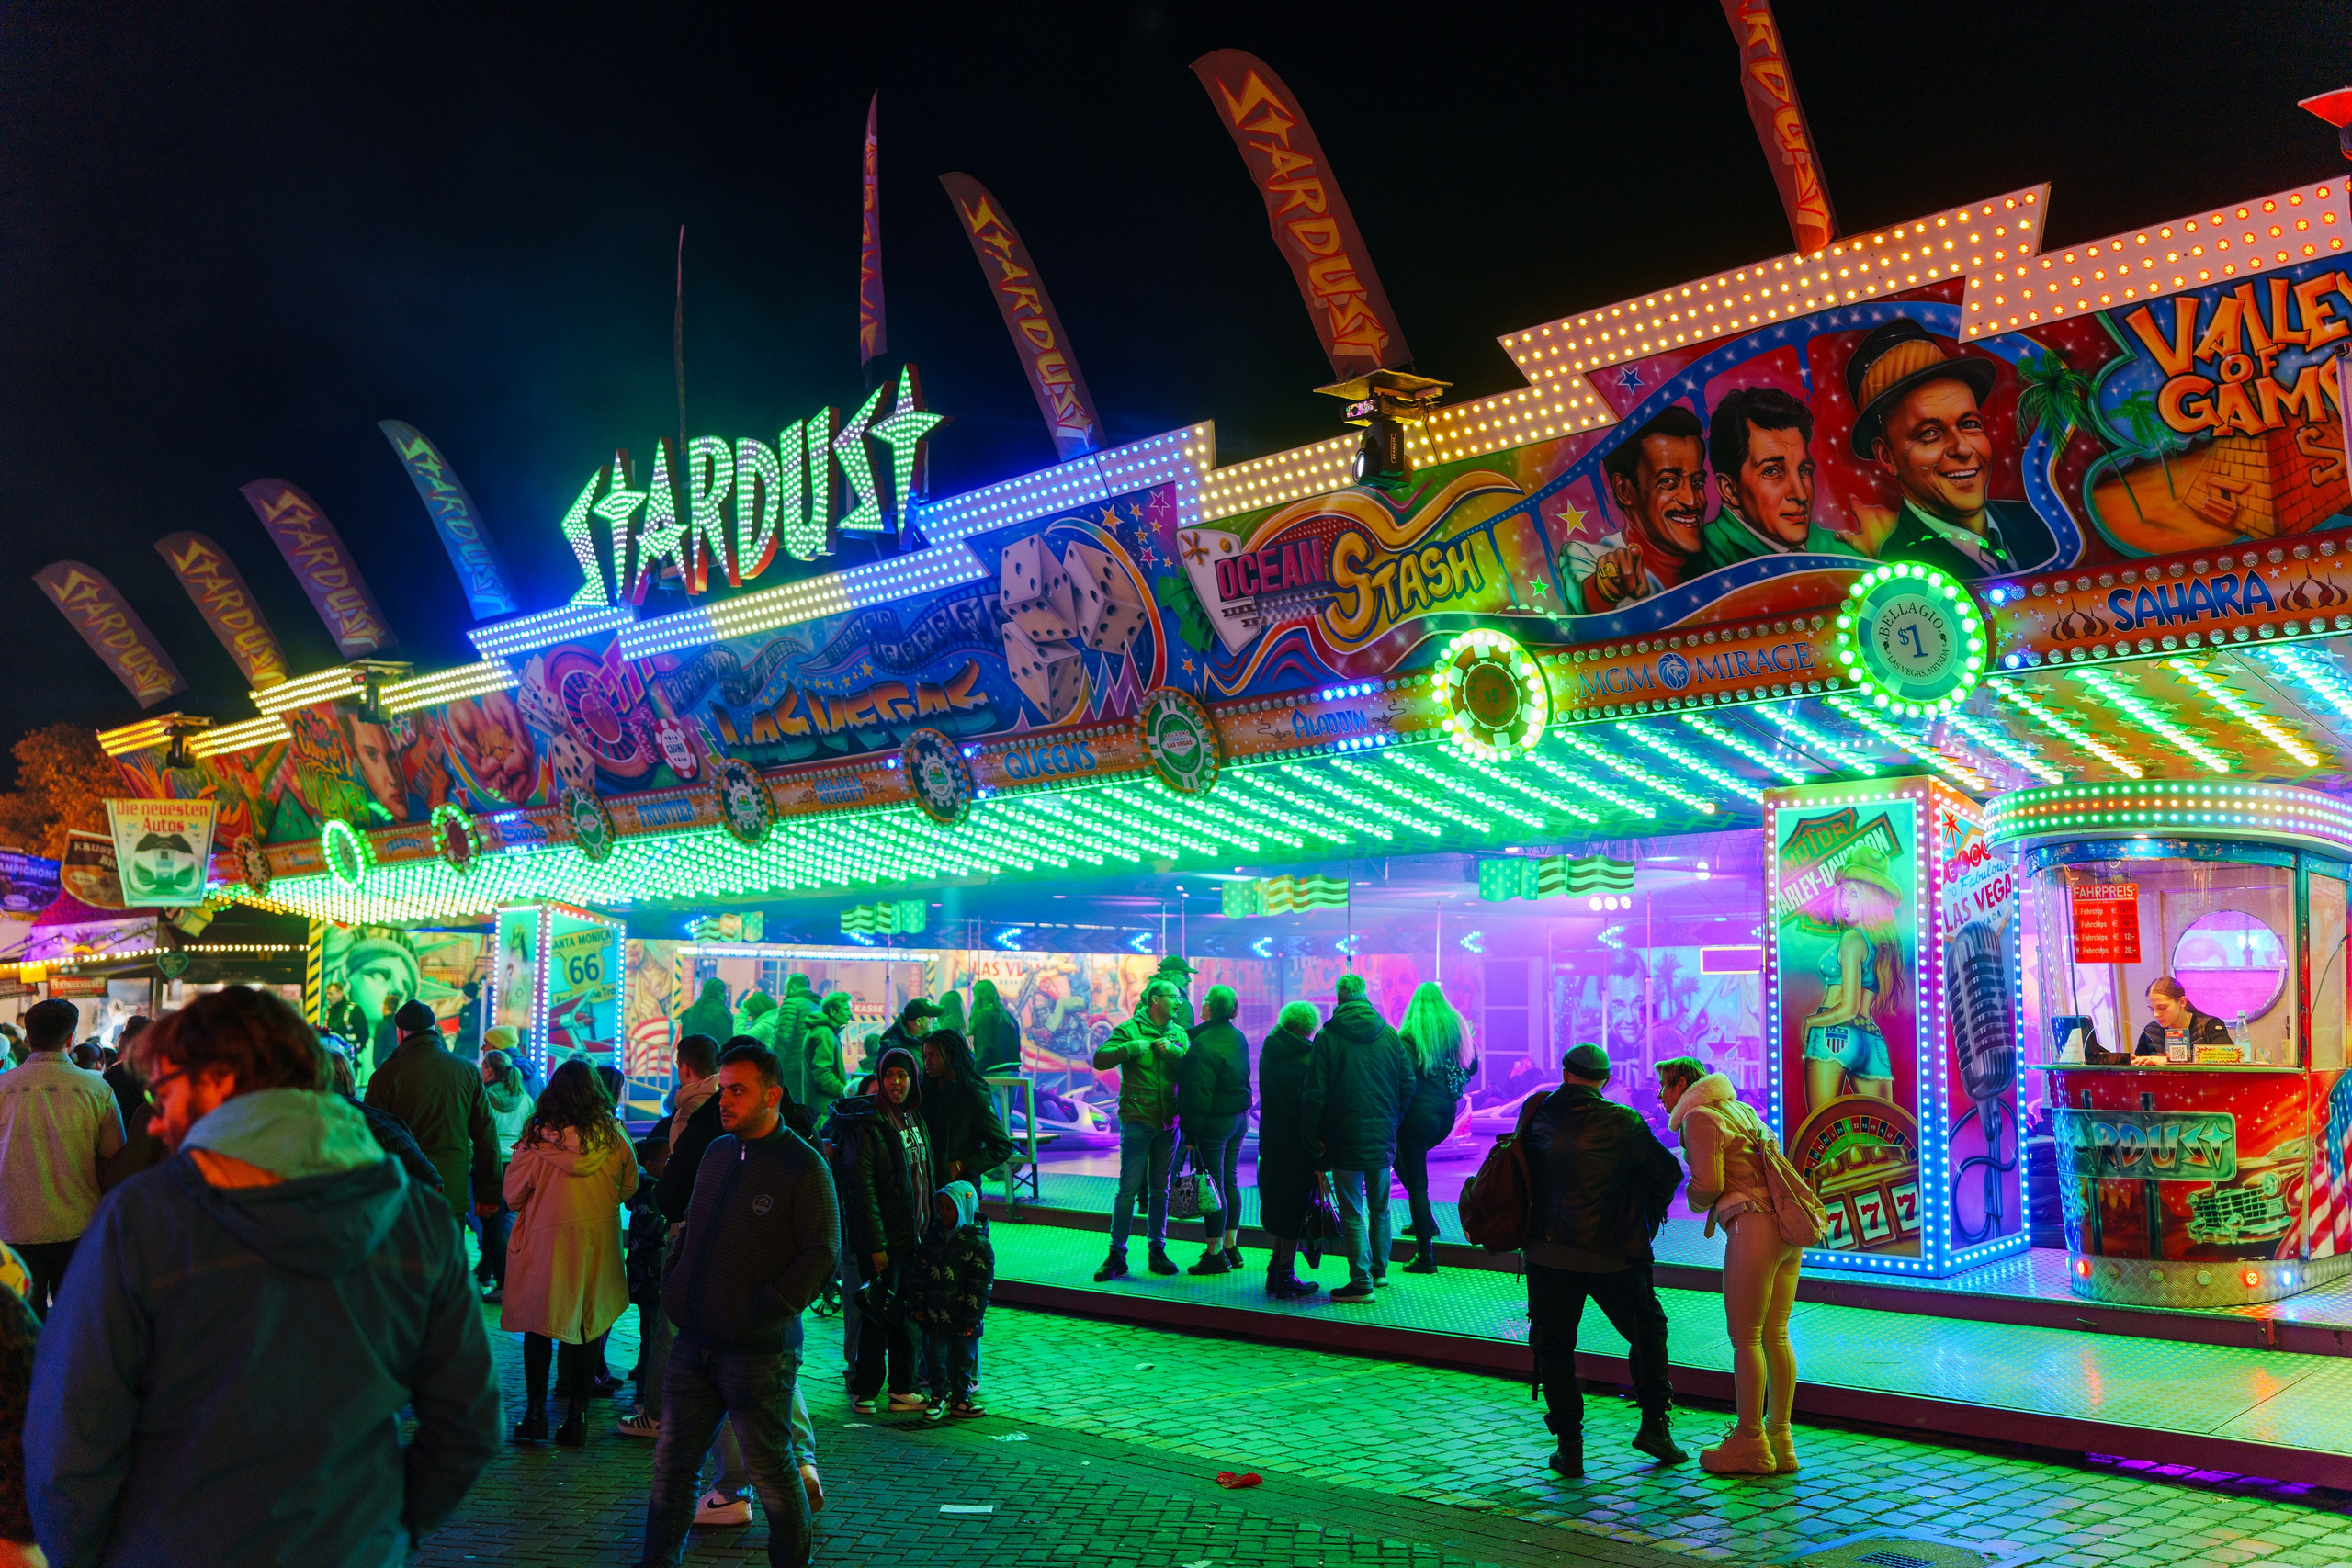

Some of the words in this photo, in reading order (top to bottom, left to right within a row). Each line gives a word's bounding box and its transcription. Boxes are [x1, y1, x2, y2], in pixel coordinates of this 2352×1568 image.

[1215, 67, 1390, 367] STARDUST
[959, 193, 1095, 451] STARDUST
[2220, 344, 2280, 383] OF
[560, 363, 952, 607] STARDUST
[397, 434, 511, 613] STARDUST
[257, 488, 386, 649] STARDUST
[1216, 537, 1328, 600] OCEAN
[1327, 530, 1483, 640] STASH
[170, 537, 288, 682] STARDUST
[2108, 569, 2277, 632] SAHARA
[48, 568, 177, 697] STARDUST
[1879, 602, 1944, 637] BELLAGIO
[1579, 664, 1656, 699] MGM
[1696, 641, 1815, 684] MIRAGE
[1888, 655, 1901, 670] LAS
[1928, 649, 1950, 675] NEVADA
[708, 680, 809, 746] LAS
[802, 657, 989, 736] VEGAS
[1479, 707, 1512, 724] NEVADA
[1291, 706, 1368, 740] ALADDIN
[666, 742, 686, 754] CASINO
[1004, 740, 1097, 780] QUEENS
[814, 774, 861, 793] GOLDEN
[818, 788, 865, 807] NUGGET
[117, 799, 139, 817] Die
[141, 801, 209, 818] neuesten
[142, 817, 185, 834] Autos
[636, 797, 697, 828] FRONTIER
[1783, 821, 1849, 873] MOTOR
[1948, 886, 1958, 897] TO
[1960, 861, 2011, 895] Fabulous
[2074, 885, 2134, 898] FAHRPREIS
[1943, 897, 1972, 933] LAS
[2080, 908, 2104, 916] Fahrchip
[2081, 920, 2108, 929] Fahrchips
[2111, 919, 2119, 928] €
[553, 937, 576, 951] ANTA
[577, 929, 613, 946] MONICA
[2081, 933, 2109, 942] Fahrchips
[2112, 932, 2120, 941] €
[2082, 946, 2109, 955] Fahrchips
[2113, 946, 2120, 954] €
[569, 953, 600, 985] 66
[974, 961, 1001, 976] LAS
[853, 1004, 885, 1012] KASSE
[1827, 1210, 1844, 1241] 7
[1860, 1201, 1880, 1231] 7
[1896, 1192, 1916, 1223] 7
